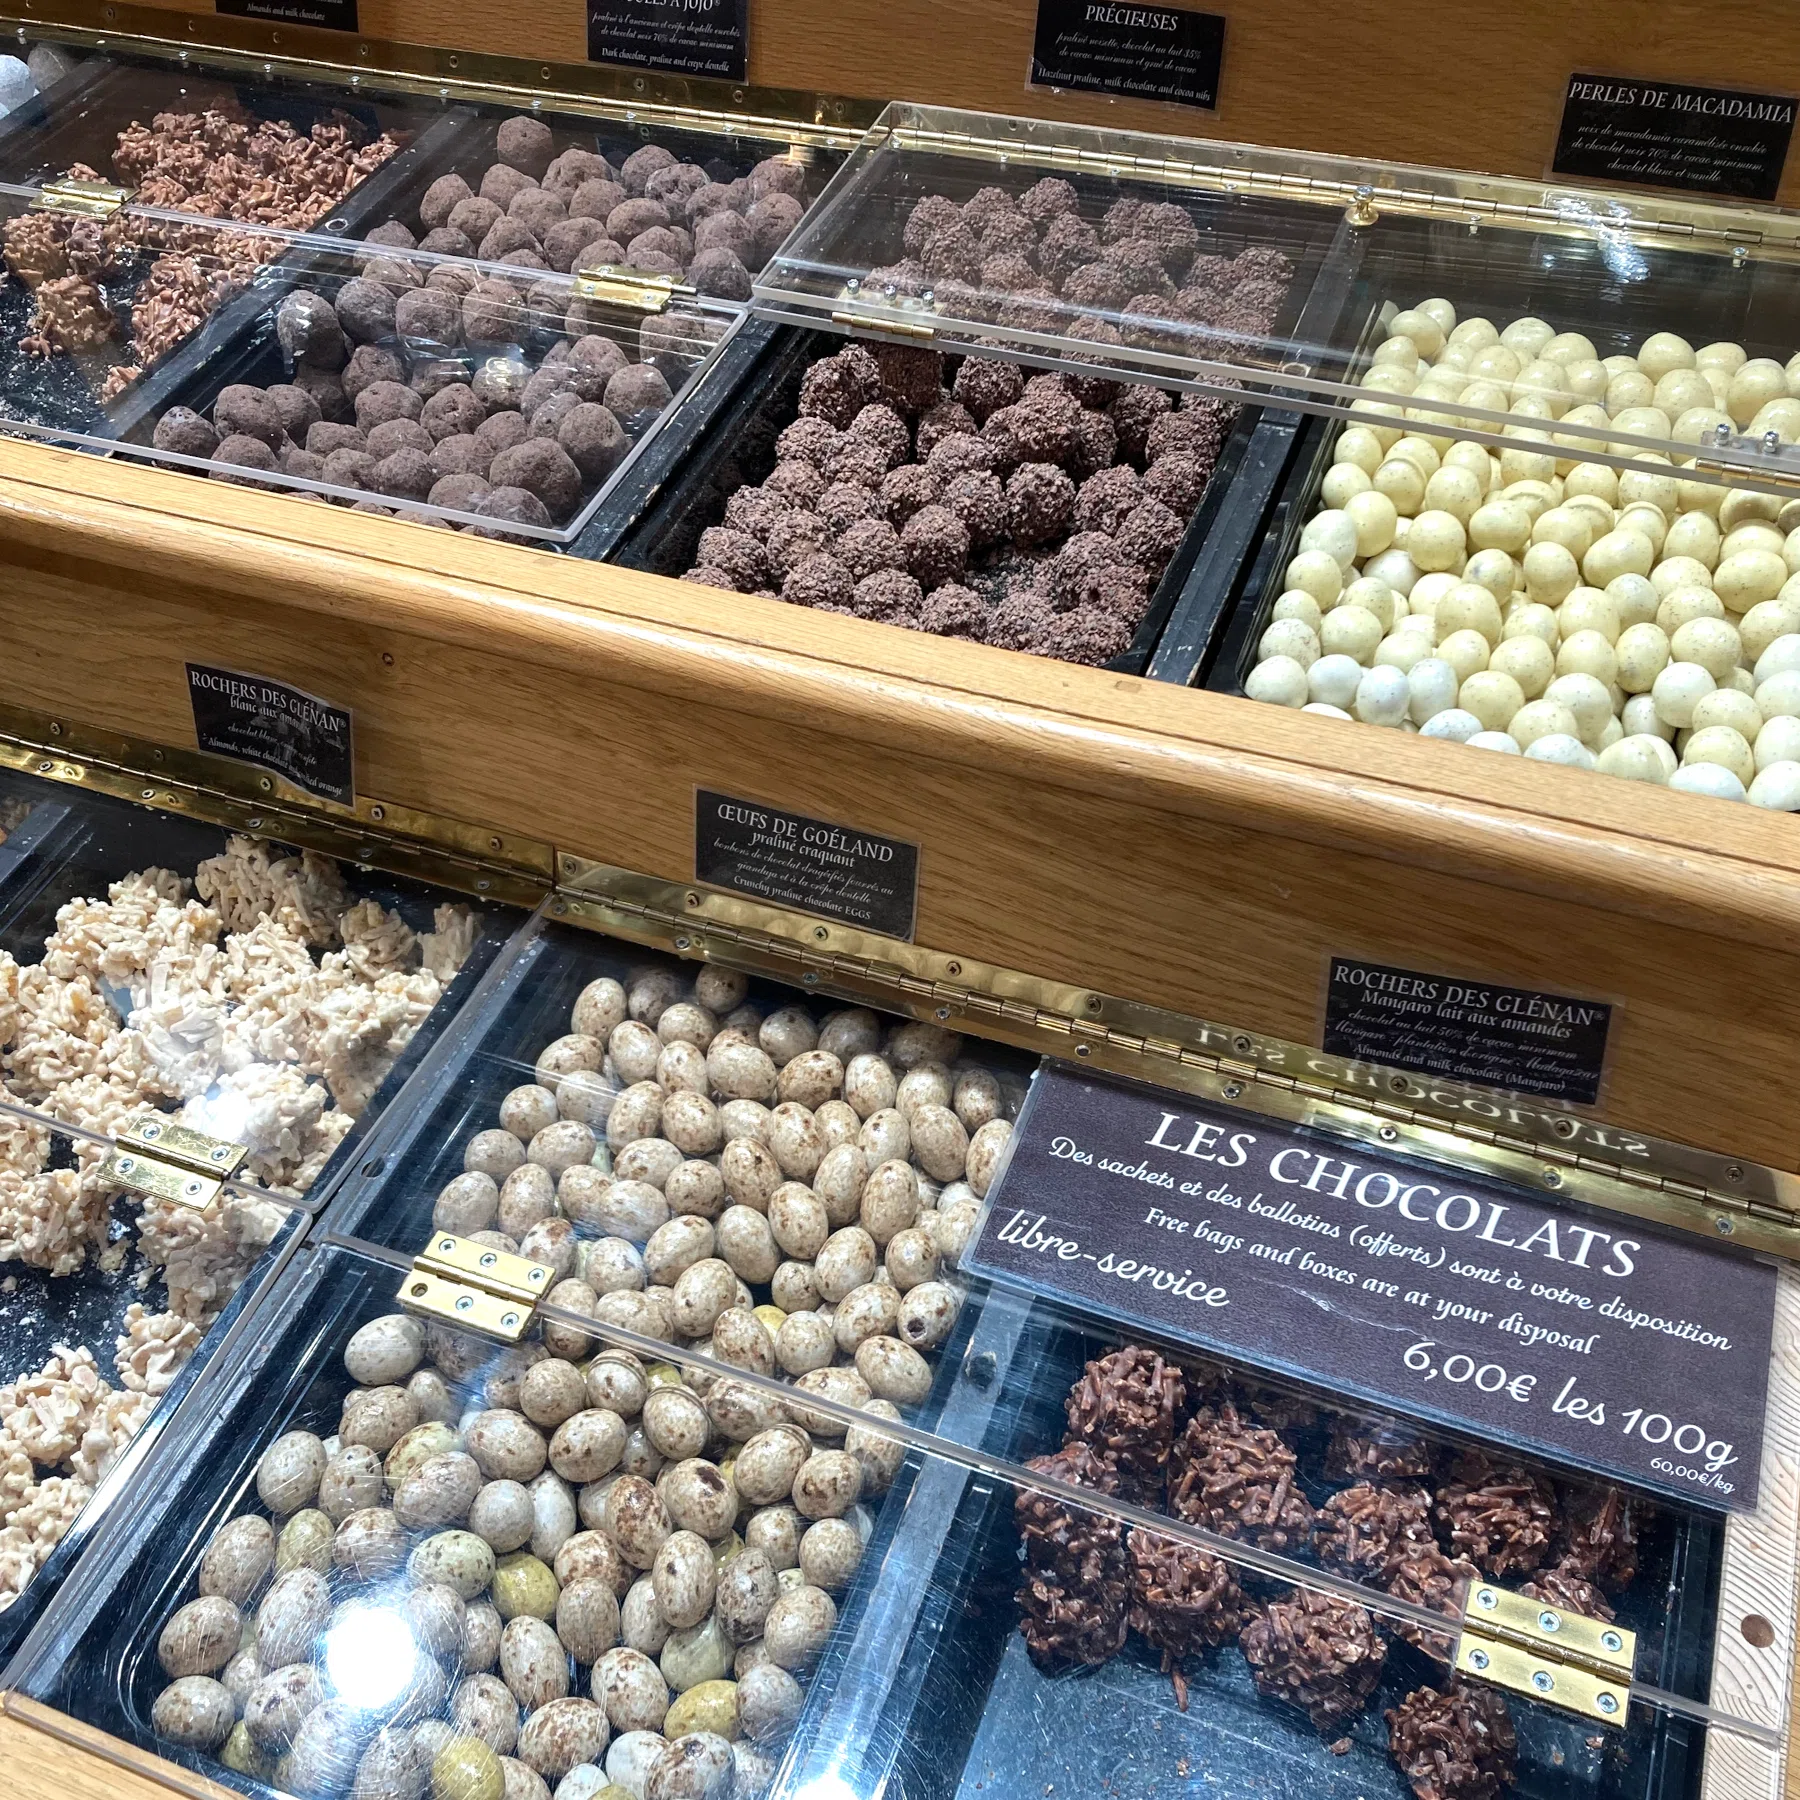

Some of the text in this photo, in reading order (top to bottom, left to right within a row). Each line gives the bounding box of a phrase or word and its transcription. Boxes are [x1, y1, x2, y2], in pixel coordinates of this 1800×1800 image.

[247, 3, 325, 20] Almonds and milk chocolate
[592, 11, 617, 23] praliné
[618, 15, 624, 23] à
[668, 22, 686, 34] crêpe
[687, 21, 714, 34] dentelle
[1085, 3, 1179, 31] PRÉCIEUSES
[600, 25, 609, 35] de
[610, 26, 637, 39] chocolat
[653, 33, 668, 42] 70%
[669, 33, 677, 44] de
[678, 38, 698, 46] cacao
[699, 39, 734, 50] minimum
[1055, 32, 1089, 45] praliné
[1089, 39, 1120, 50] noisette,
[1121, 38, 1156, 52] chocolat
[1168, 44, 1183, 57] lait
[1183, 49, 1201, 60] 35%
[602, 48, 618, 57] Dark
[619, 49, 648, 62] chocolate,
[648, 54, 672, 66] praline
[673, 56, 687, 66] and
[705, 60, 730, 71] dentelle
[1059, 45, 1197, 74] de cacao minimum et grué de cacao
[1038, 67, 1211, 101] Hazelnut praline, milk chocolate and cocoa nibs
[1568, 82, 1792, 123] PERLES DE MACADAMIA
[1571, 136, 1764, 172] de chocolat noir 70% de cacao minimum,
[1578, 123, 1767, 153] noix de macadamia caramélisée enrobée
[1607, 157, 1721, 181] chocolat blanc et vanille
[191, 670, 257, 700] ROCHERS
[261, 687, 286, 708] DES
[230, 695, 257, 713] blanc
[258, 706, 277, 718] aux
[227, 722, 258, 737] chocolat
[208, 736, 240, 753] Almonds,
[242, 744, 262, 757] white
[263, 750, 288, 768] chocolate
[319, 783, 342, 797] orange
[717, 803, 893, 862] ŒUFS DE GOÉLAND
[747, 832, 855, 868] praliné craquant
[713, 837, 749, 856] bonbons
[751, 849, 762, 859] de
[763, 852, 801, 870] chocolat
[844, 874, 879, 892] fourrés
[881, 887, 894, 895] au
[736, 862, 872, 904] gianduja et à la crêpe dentelle
[733, 875, 872, 920] Crunchy praline chocolate EGGS
[1333, 965, 1604, 1026] ROCHERS DES GLÉNAN®
[1361, 990, 1572, 1039] Mangaro lait aux amandes
[1348, 1008, 1395, 1026] chocolat
[1414, 1020, 1438, 1033] lait
[1437, 1026, 1464, 1040] 50%
[1466, 1030, 1480, 1042] de
[1482, 1038, 1515, 1049] cacao
[1518, 1040, 1578, 1059] minimum
[1393, 1033, 1457, 1055] plantation
[1353, 1043, 1566, 1092] Almonds and milk chocolate (Mangaro)
[1144, 1111, 1642, 1277] LES CHOCOLATS
[997, 1209, 1230, 1307] libre-service
[1048, 1136, 1733, 1350] Des sachets et des ballotins (offerts) sont à votre disposition
[1143, 1207, 1601, 1355] Free bags and boxes are at your disposal
[1403, 1342, 1739, 1472] 6,00€ les 100g
[1650, 1457, 1736, 1494] 60,00€/kg
